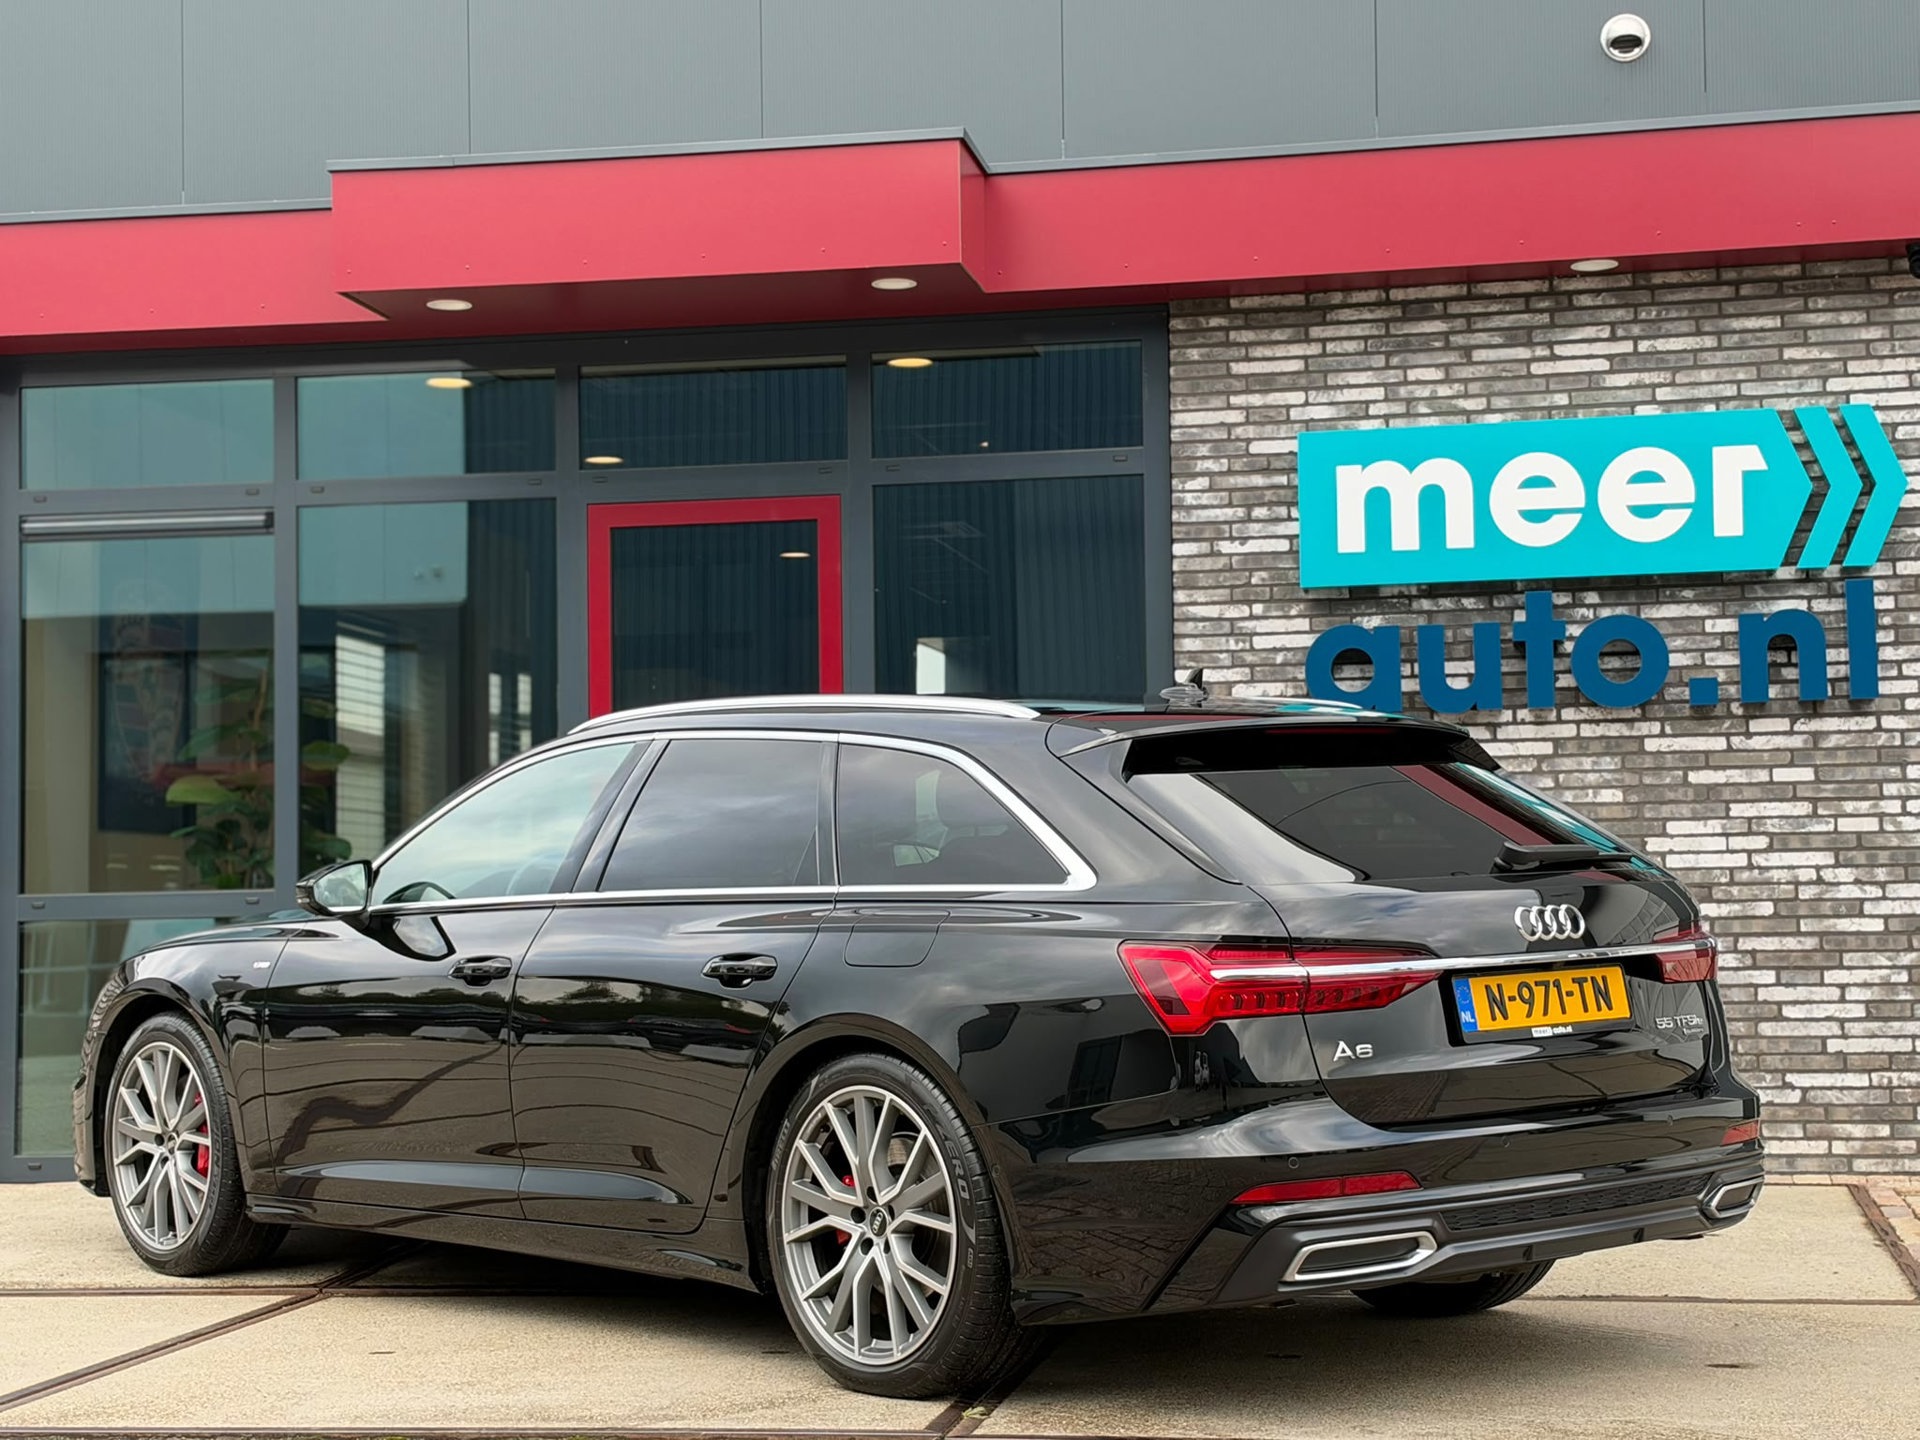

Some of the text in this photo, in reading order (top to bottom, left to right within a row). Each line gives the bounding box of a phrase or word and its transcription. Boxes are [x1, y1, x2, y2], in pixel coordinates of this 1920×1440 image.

[1336, 444, 1768, 554] meer
[1305, 578, 1879, 713] auto.nl
[1484, 975, 1614, 1022] N-971-TN
[1461, 1010, 1475, 1023] NL
[1655, 1016, 1674, 1029] 55
[1333, 1040, 1373, 1062] A6
